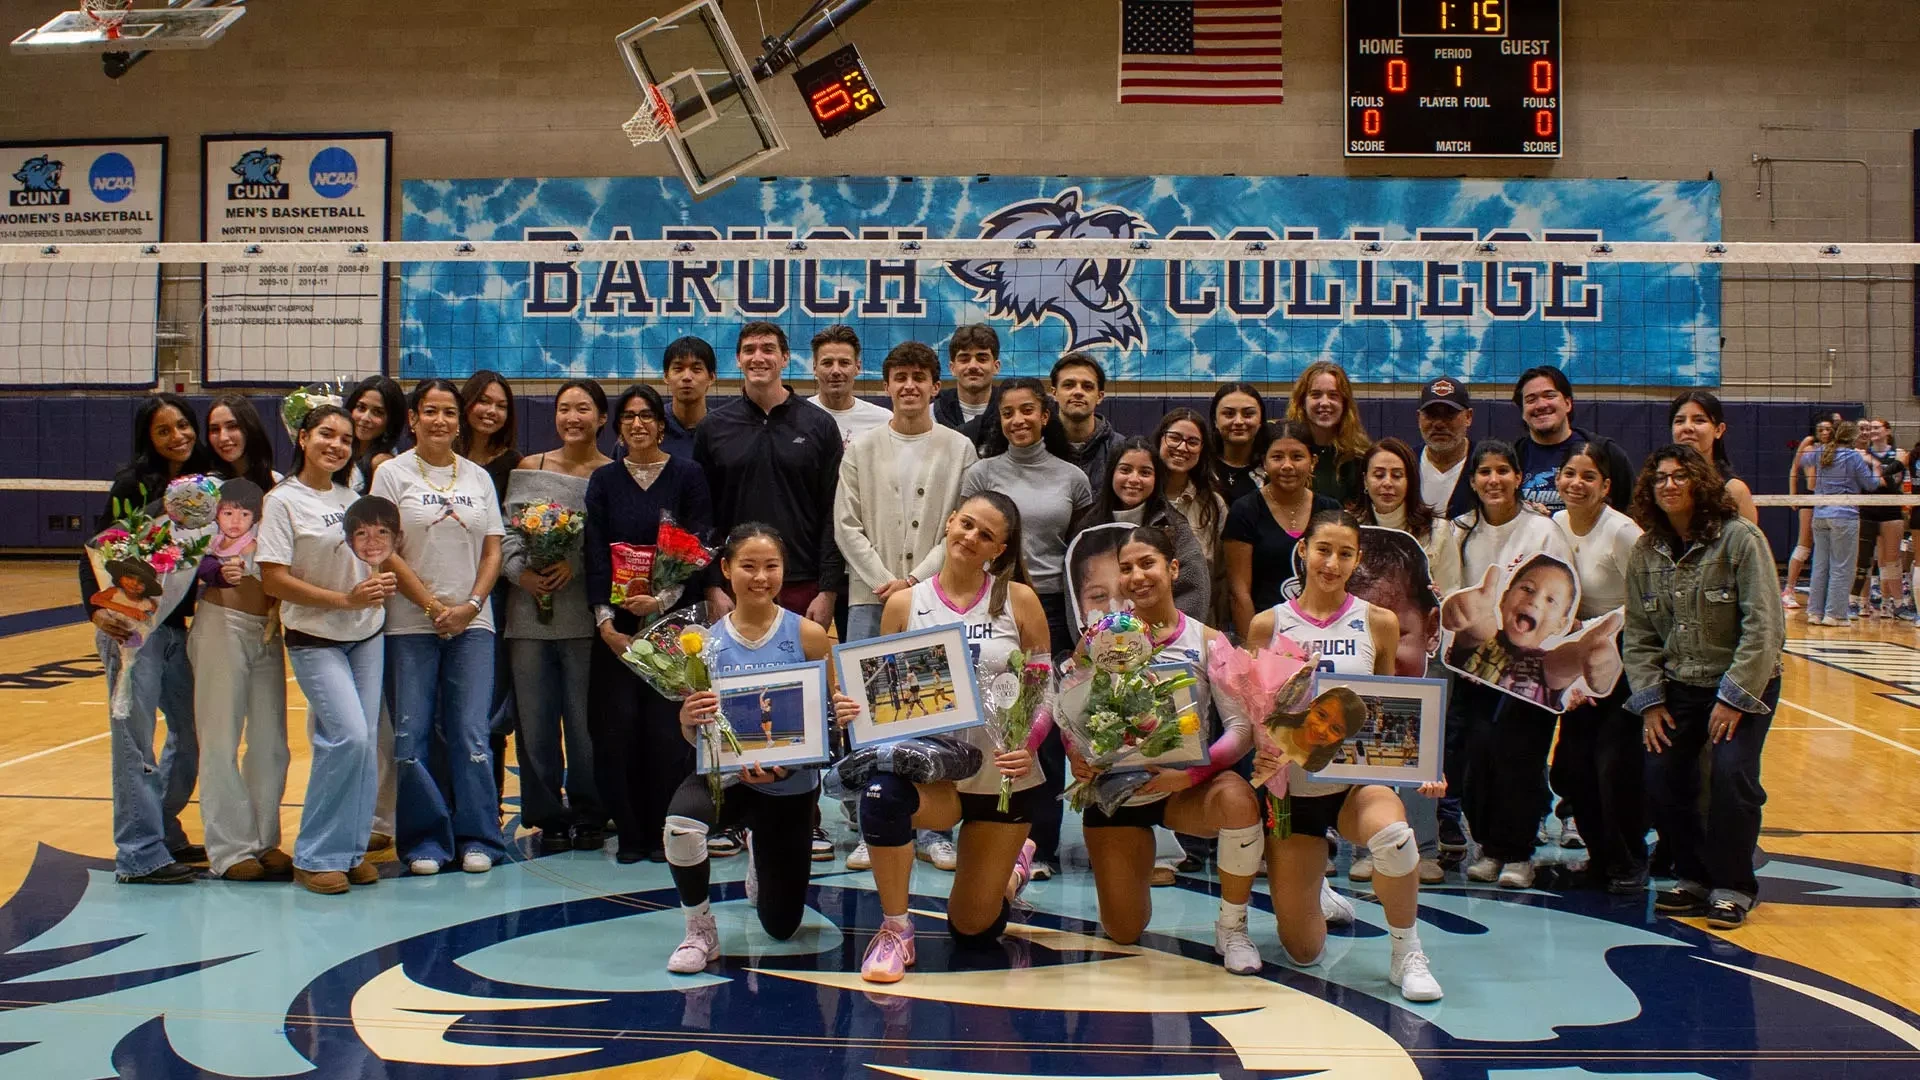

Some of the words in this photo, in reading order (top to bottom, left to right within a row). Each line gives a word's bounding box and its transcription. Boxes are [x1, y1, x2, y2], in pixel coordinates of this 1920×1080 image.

[1441, 0, 1501, 31] 1:15
[1359, 39, 1404, 54] HOME
[1434, 48, 1472, 59] PERIOD
[1501, 40, 1550, 55] GUEST
[1388, 60, 1407, 91] 0
[1456, 66, 1462, 87] 1
[1533, 61, 1551, 92] 0
[843, 71, 875, 110] 1:15
[1351, 96, 1384, 107] FOULS
[1420, 97, 1458, 108] PLAYER
[1464, 97, 1491, 108] FOUL
[1523, 97, 1556, 108] FOULS
[1364, 109, 1380, 134] 0
[1536, 110, 1552, 136] 0
[1351, 141, 1385, 152] SCORE
[1436, 142, 1471, 152] MATCH
[1523, 142, 1557, 153] SCORE
[93, 176, 134, 191] NCAA
[314, 172, 356, 186] NCAA
[16, 190, 63, 205] CUNY
[234, 185, 282, 199] CUNY
[0, 212, 60, 225] WOMEN'S
[65, 211, 154, 223] BASKETBALL
[226, 207, 268, 218] MEN'S
[272, 207, 365, 218] BASKETBALL
[18, 229, 59, 238] CONFERENCE
[65, 228, 105, 237] TOURNAMENT
[107, 227, 143, 236] CHAMPIONS
[222, 226, 256, 235] NORTH
[260, 226, 306, 235] DIVISION
[307, 225, 369, 234] CHAMPIONS
[522, 226, 928, 318] BARUCH
[1165, 226, 1604, 322] COLLEGE
[235, 304, 277, 312] TOURNAMENT
[278, 304, 314, 312] CHAMPIONS
[283, 317, 325, 325] TOURNAMENT
[327, 317, 364, 325] CHAMPIONS
[423, 494, 474, 508] KAINA
[965, 622, 993, 639] UCH
